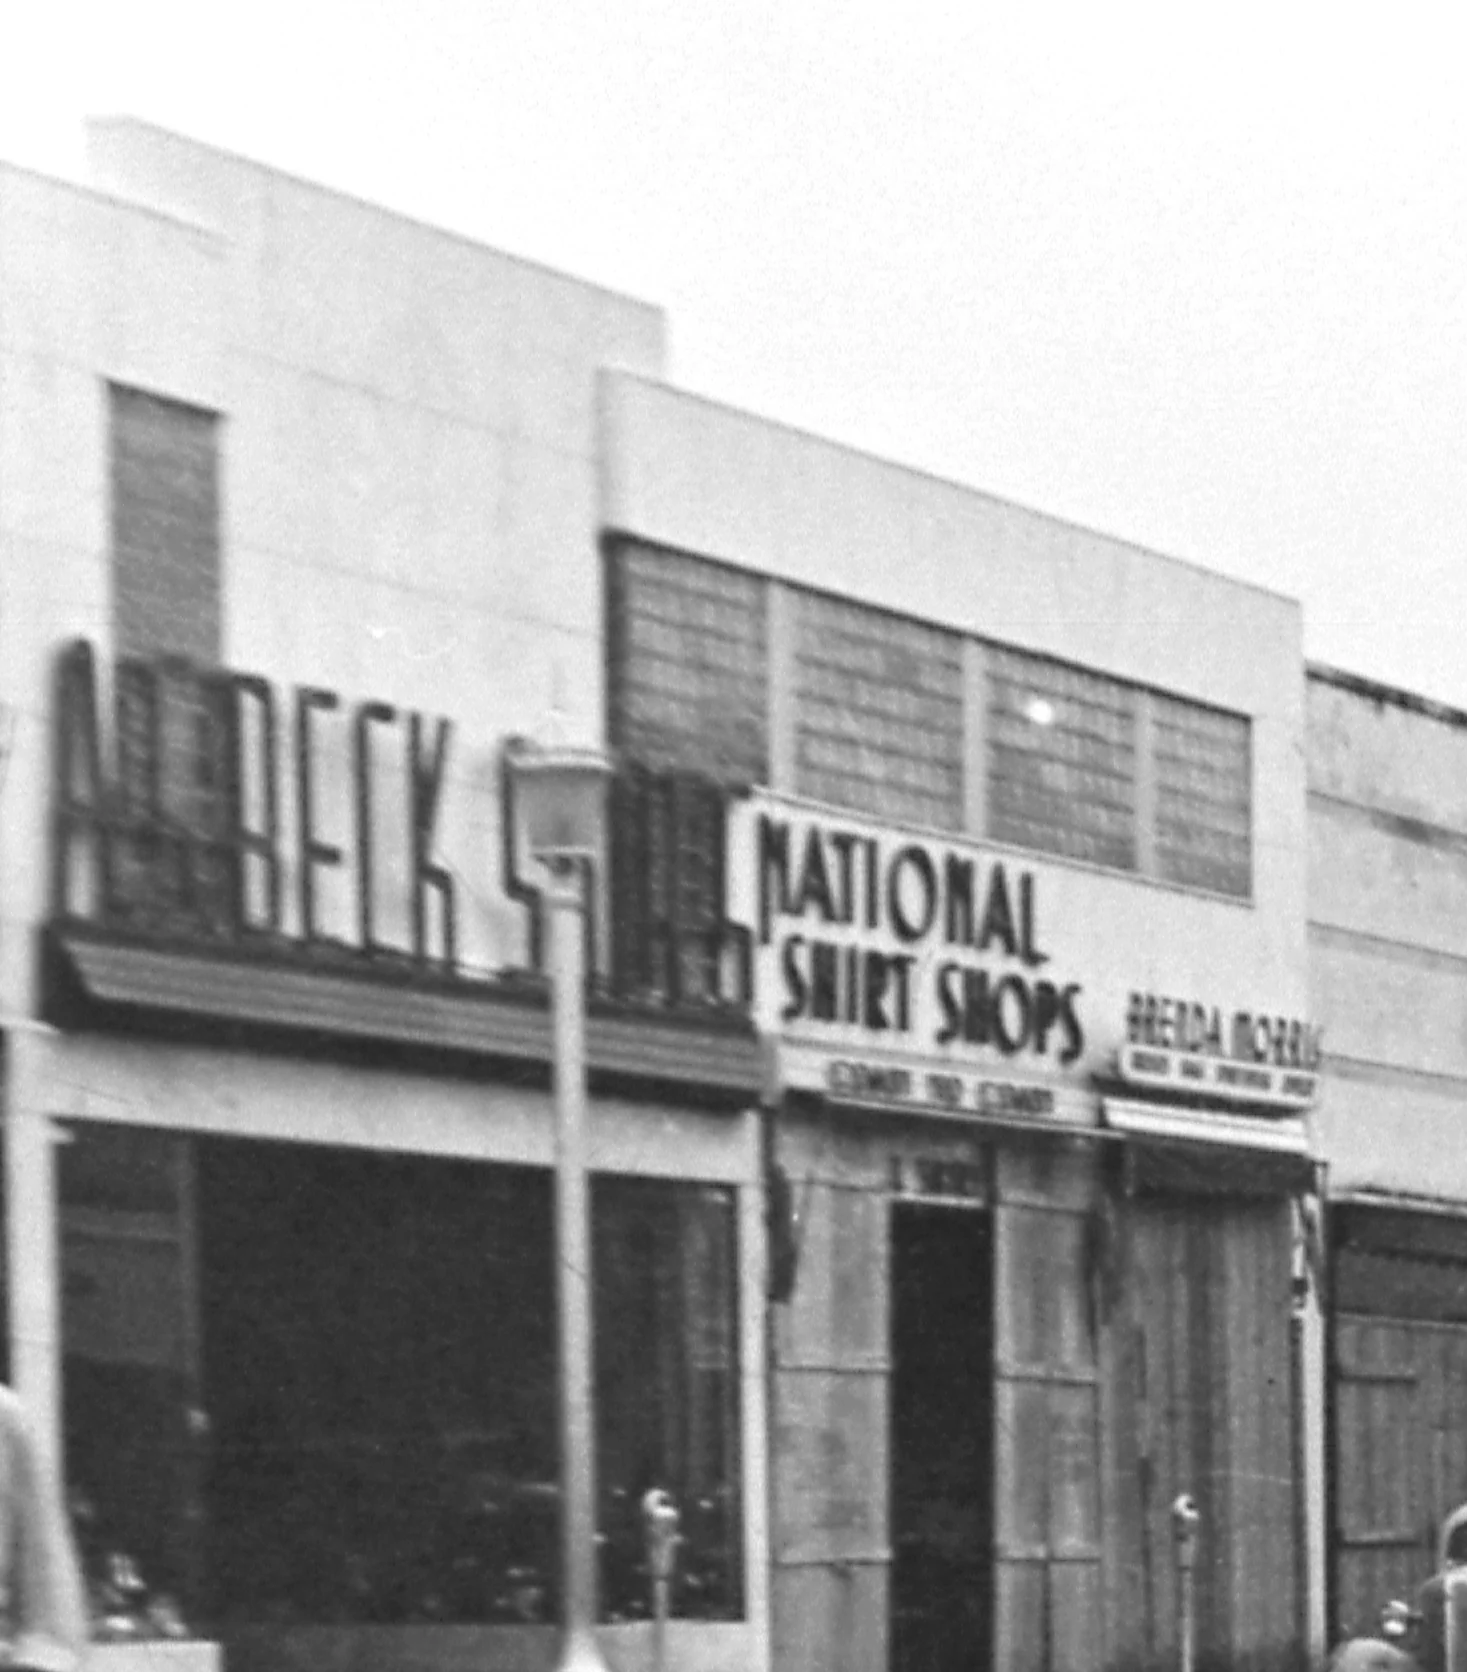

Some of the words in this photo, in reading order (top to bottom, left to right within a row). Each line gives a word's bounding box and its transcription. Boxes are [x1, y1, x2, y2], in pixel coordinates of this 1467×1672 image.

[757, 813, 1049, 966] NATIONAL
[782, 935, 918, 1033] SHIRT
[935, 963, 1084, 1066] SHOPS
